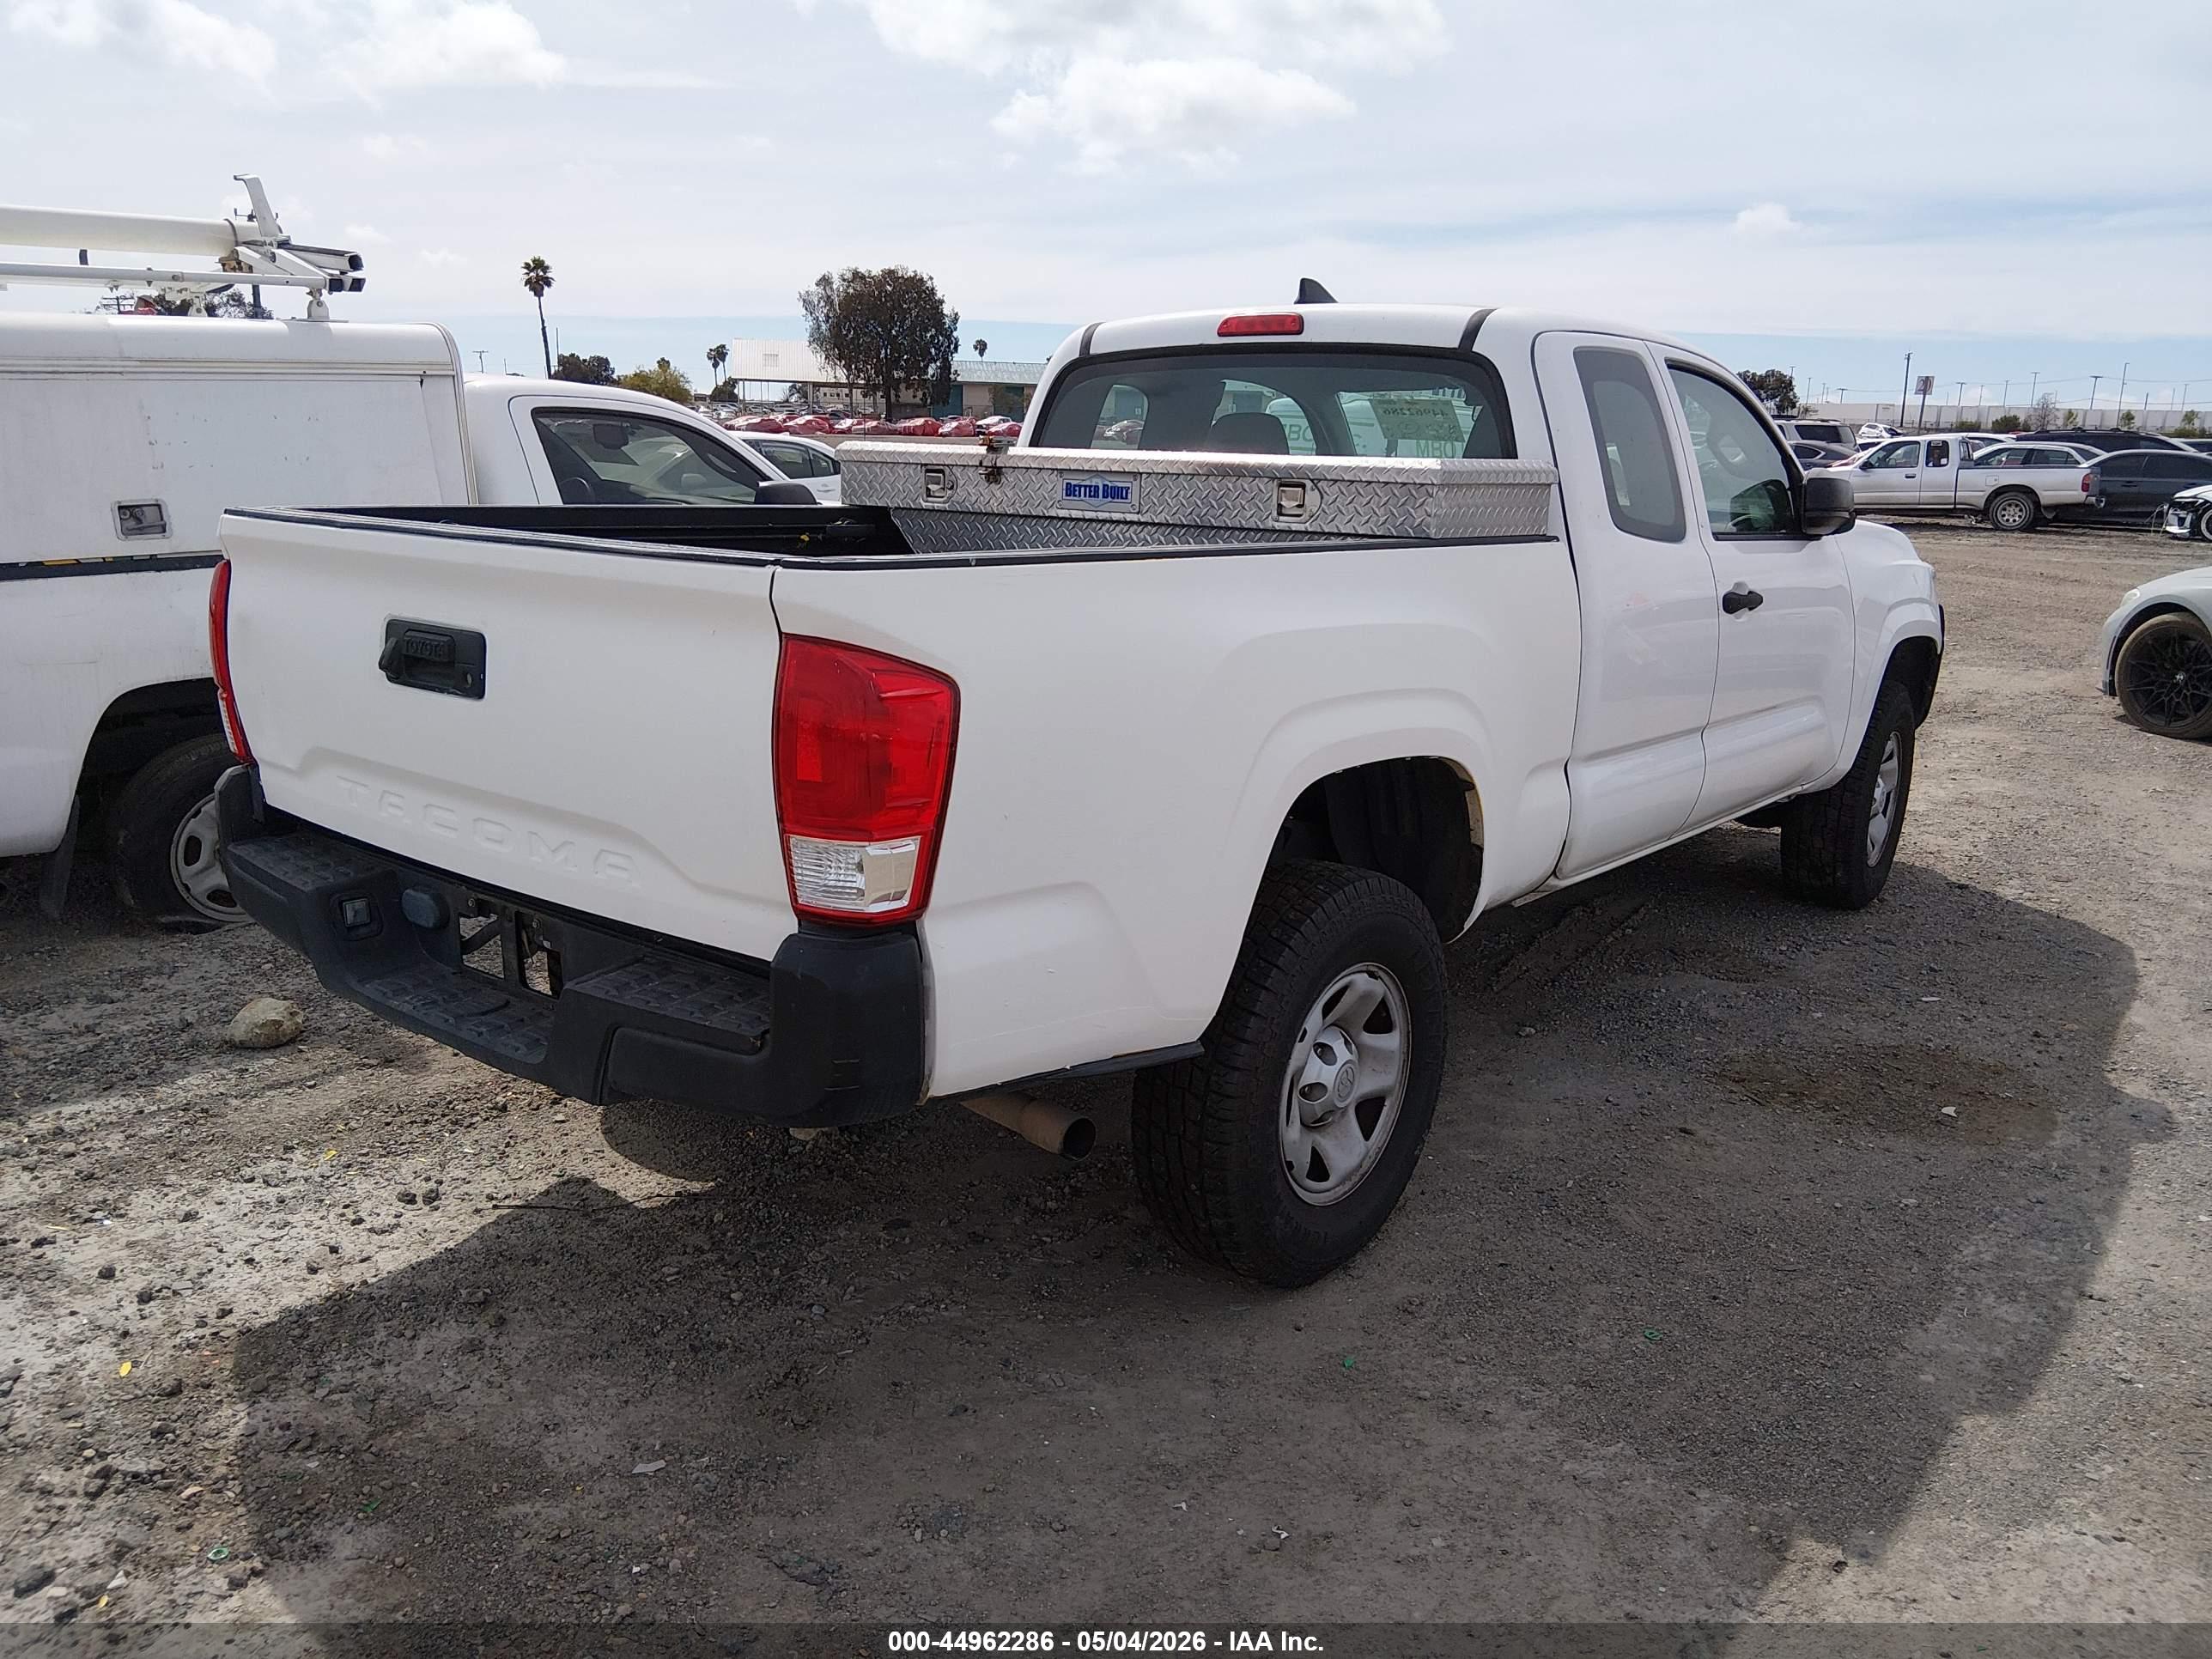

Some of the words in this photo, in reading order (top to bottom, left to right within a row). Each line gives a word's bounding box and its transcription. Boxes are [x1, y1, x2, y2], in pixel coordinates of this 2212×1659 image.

[1065, 482, 1100, 498] BETTER
[1102, 483, 1130, 500] BUILT
[404, 638, 447, 660] TOYOTA
[337, 775, 641, 888] TACOMA
